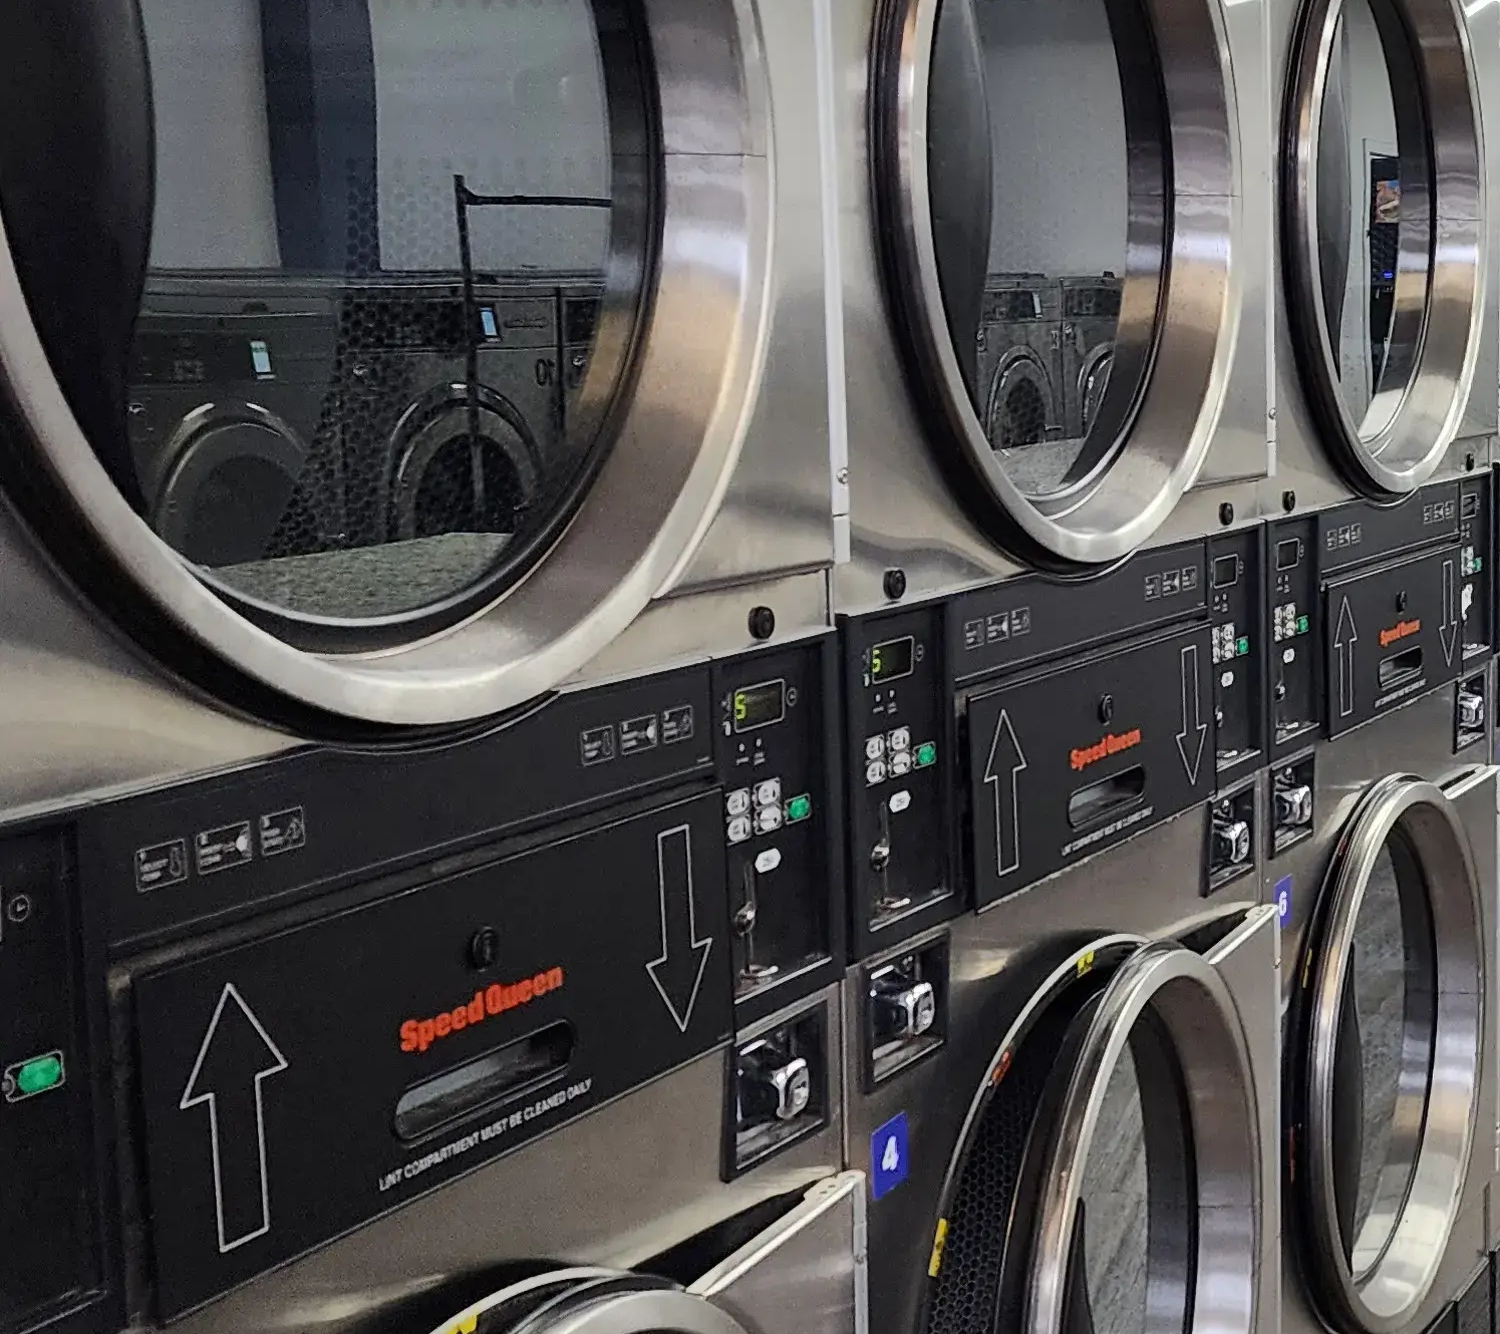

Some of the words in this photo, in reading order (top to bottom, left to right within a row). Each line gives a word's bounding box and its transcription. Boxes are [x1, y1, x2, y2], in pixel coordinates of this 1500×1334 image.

[1279, 890, 1287, 916] 6
[400, 992, 484, 1051] Speed
[485, 966, 564, 1014] Queen
[403, 1131, 480, 1179] COMPARTMENT
[480, 1118, 508, 1142] MUST
[509, 1110, 523, 1129] BE
[523, 1091, 566, 1121] CLEANED
[566, 1077, 593, 1103] DAILY
[881, 1135, 900, 1171] 4
